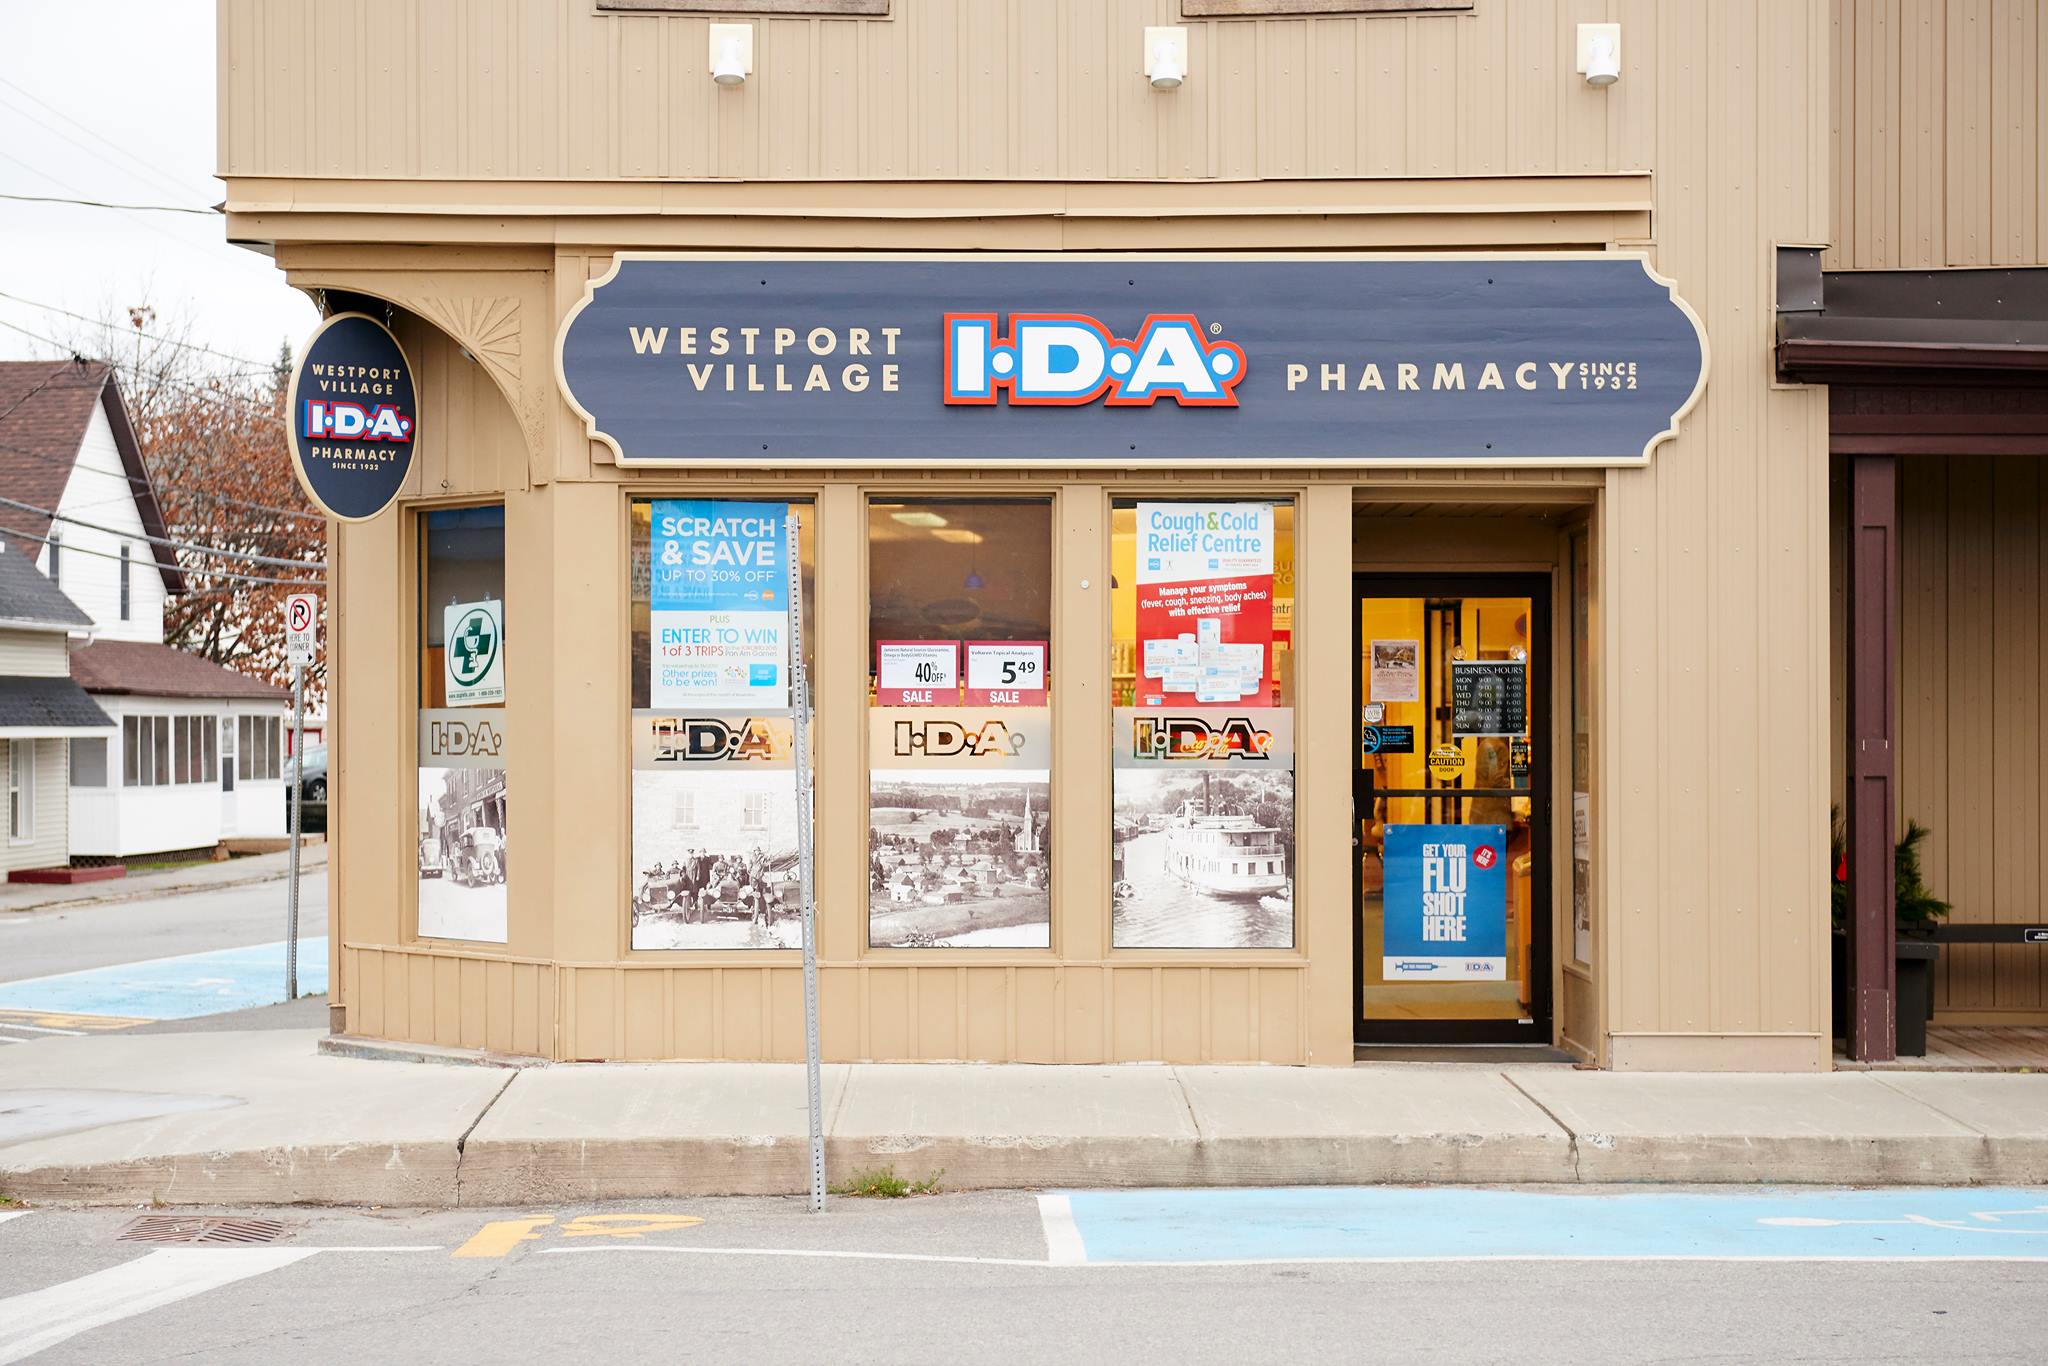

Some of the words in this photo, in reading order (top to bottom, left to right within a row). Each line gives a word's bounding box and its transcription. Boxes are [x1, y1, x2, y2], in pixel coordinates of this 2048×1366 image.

[629, 327, 901, 356] WESTPORT
[312, 364, 400, 380] WESTPORT
[1579, 362, 1638, 376] SINCE
[687, 363, 900, 392] VILLAGE
[1286, 362, 1575, 392] PHARMACY
[1580, 376, 1638, 390] 1932
[319, 380, 393, 395] VILLAGE
[311, 446, 396, 461] PHARMACY
[332, 462, 357, 470] SINCE
[360, 462, 379, 471] 1932
[661, 517, 776, 537] SCRATCH
[1147, 533, 1197, 552] Relief
[1202, 534, 1261, 553] Centre
[661, 540, 683, 565] &
[691, 540, 776, 566] SAVE
[662, 570, 682, 582] UP
[686, 570, 706, 582] TO
[1159, 586, 1188, 597] Manage
[1189, 585, 1206, 596] your
[1208, 581, 1247, 594] symptoms
[1141, 598, 1164, 609] (fever,
[1165, 597, 1189, 608] cough,
[1190, 595, 1223, 606] sneezing,
[1224, 592, 1242, 604] body
[1243, 591, 1267, 602] aches)
[1168, 607, 1186, 617] with
[1187, 605, 1220, 616] effective
[1221, 602, 1241, 613] relief
[710, 615, 730, 624] PLUS
[662, 628, 711, 643] ENTER
[715, 628, 739, 643] TO
[744, 628, 777, 643] WIN
[662, 646, 666, 656] 1
[669, 646, 682, 657] of
[685, 646, 691, 656] 3
[696, 646, 724, 657] TRIPS
[662, 669, 690, 678] Other
[691, 669, 718, 680] prizes
[662, 678, 672, 687] to
[676, 678, 690, 687] be
[902, 690, 933, 703] SALE
[989, 691, 1019, 703] SALE
[1423, 844, 1439, 857] GET
[1442, 844, 1466, 857] YOUR
[1423, 857, 1467, 893] FLU
[1423, 892, 1467, 916] SHOT
[1423, 916, 1467, 941] HERE
